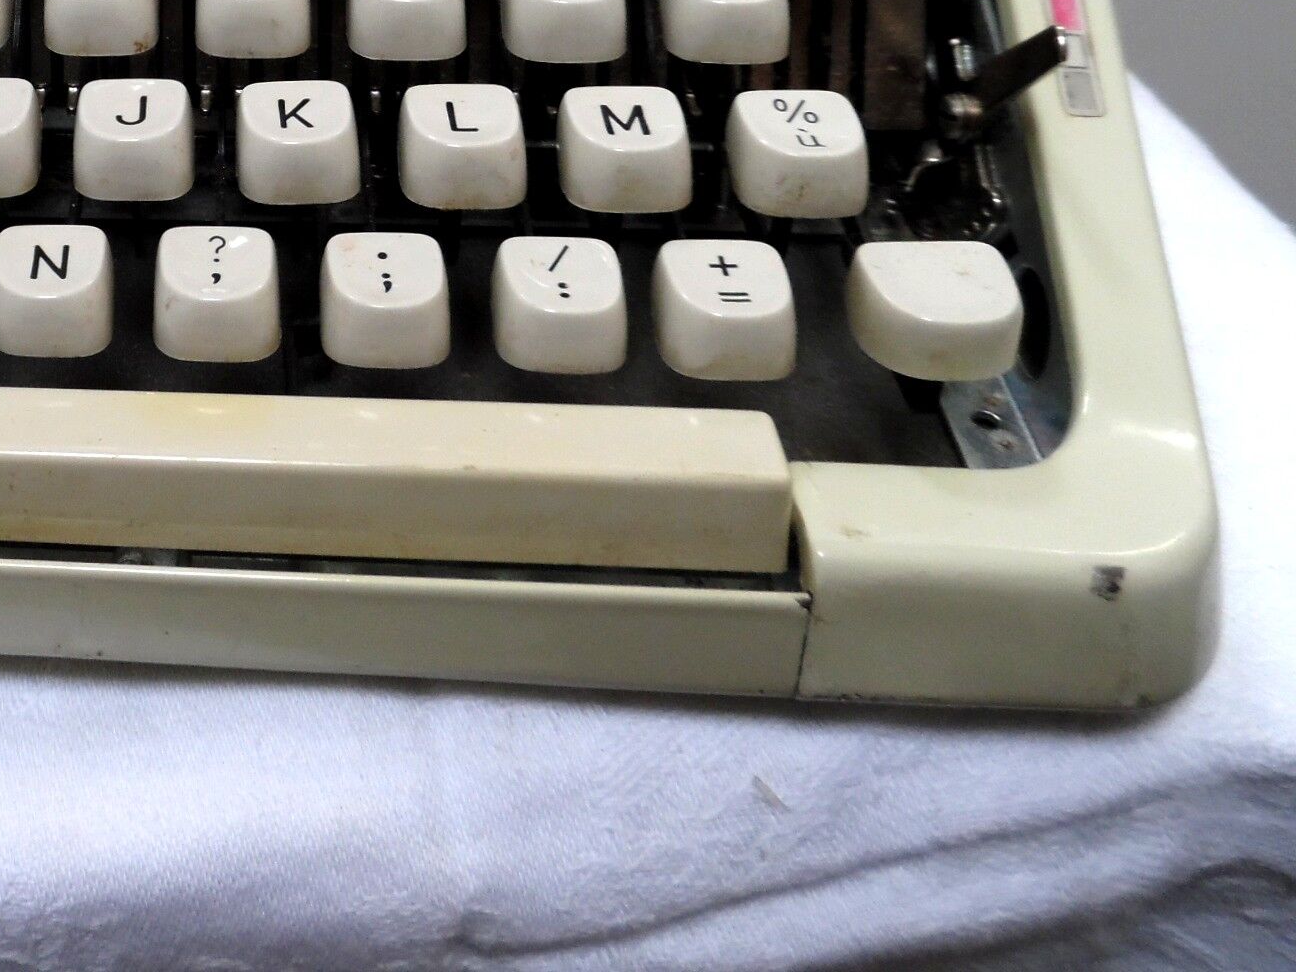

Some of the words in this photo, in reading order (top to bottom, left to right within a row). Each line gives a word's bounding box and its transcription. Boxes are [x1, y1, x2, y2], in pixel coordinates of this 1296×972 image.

[115, 95, 148, 126] J
[277, 98, 314, 129] K
[445, 101, 479, 133] L
[599, 104, 651, 136] M
[772, 98, 819, 124] %
[29, 244, 70, 280] N
[208, 235, 227, 263] ?
[548, 245, 569, 273] /
[708, 255, 739, 277] +
[718, 291, 752, 303] =
